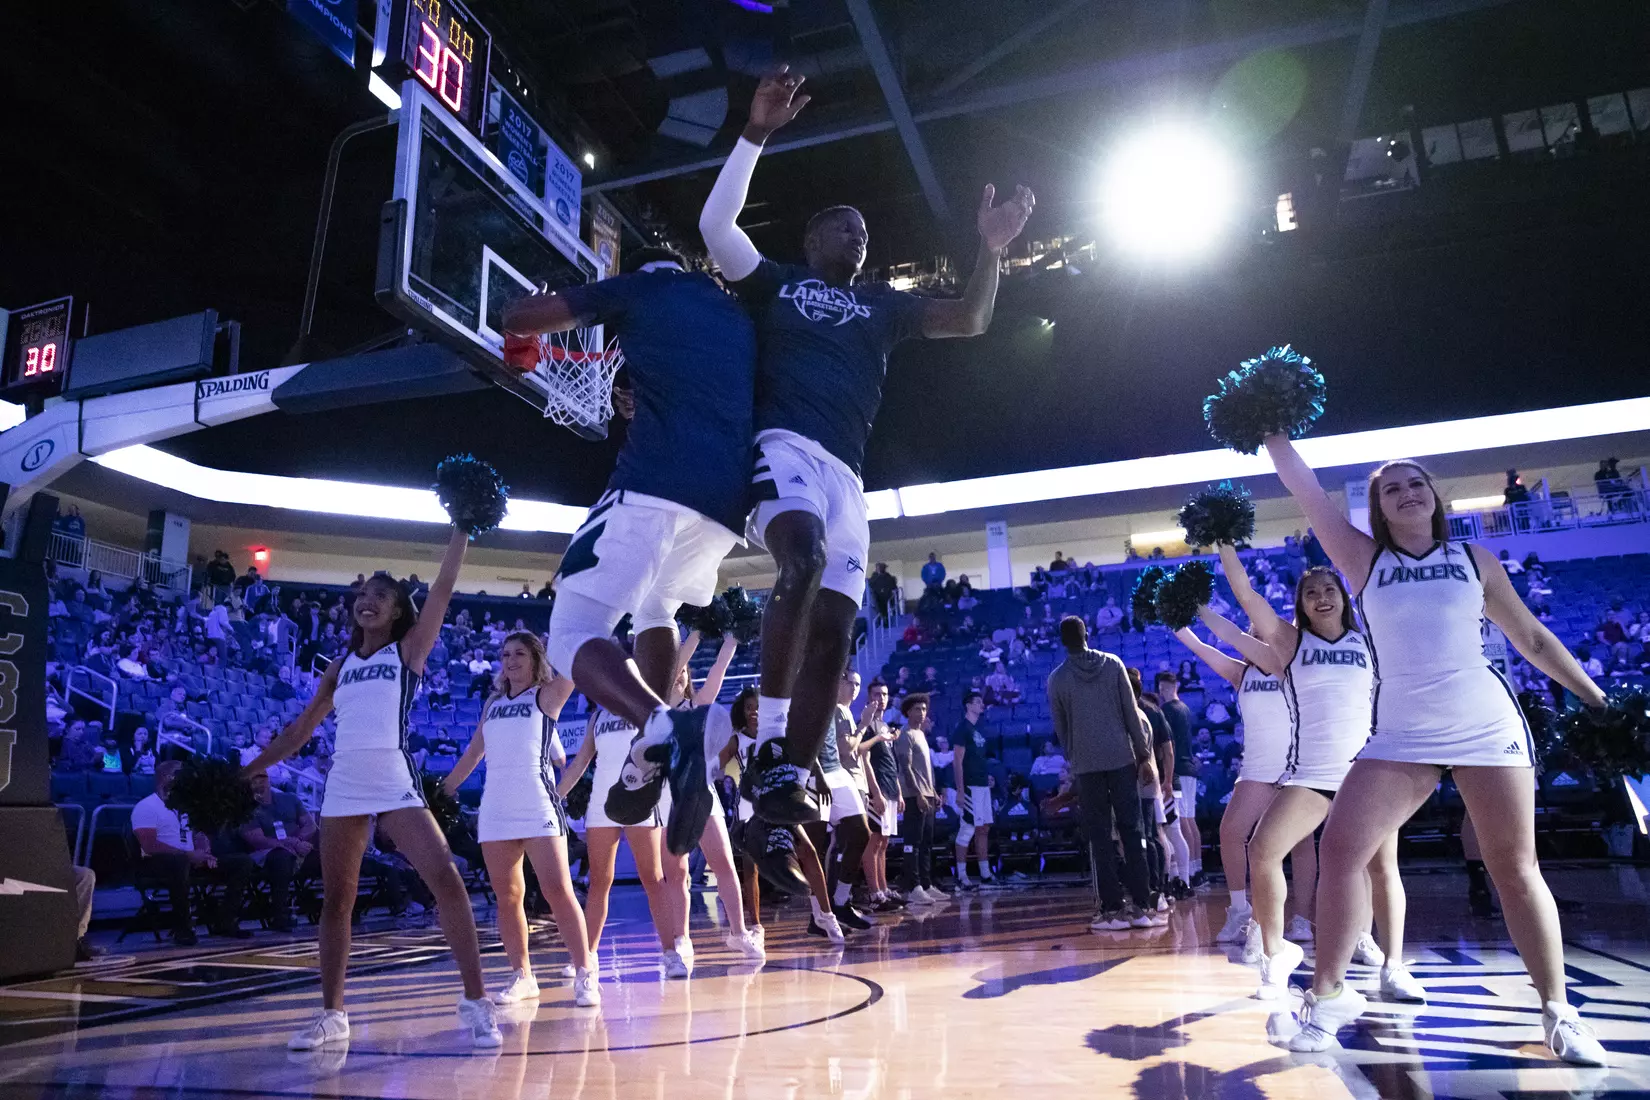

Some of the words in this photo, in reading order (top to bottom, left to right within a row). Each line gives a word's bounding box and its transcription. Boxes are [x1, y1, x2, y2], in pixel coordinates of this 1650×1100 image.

[416, 21, 464, 112] 30
[508, 108, 532, 138] 2017
[502, 125, 538, 167] BASKETBALL
[554, 159, 575, 183] 2017
[21, 304, 65, 320] DAKTRONICS
[779, 284, 872, 319] LANCERS
[805, 300, 843, 313] BASKETBALL
[24, 343, 57, 377] 30
[197, 371, 270, 400] SPALDING
[1377, 563, 1469, 588] LANCERS
[1301, 648, 1367, 669] LANCERS
[488, 702, 534, 720] ANCERS
[595, 718, 636, 737] LANCER
[563, 739, 578, 749] UP!
